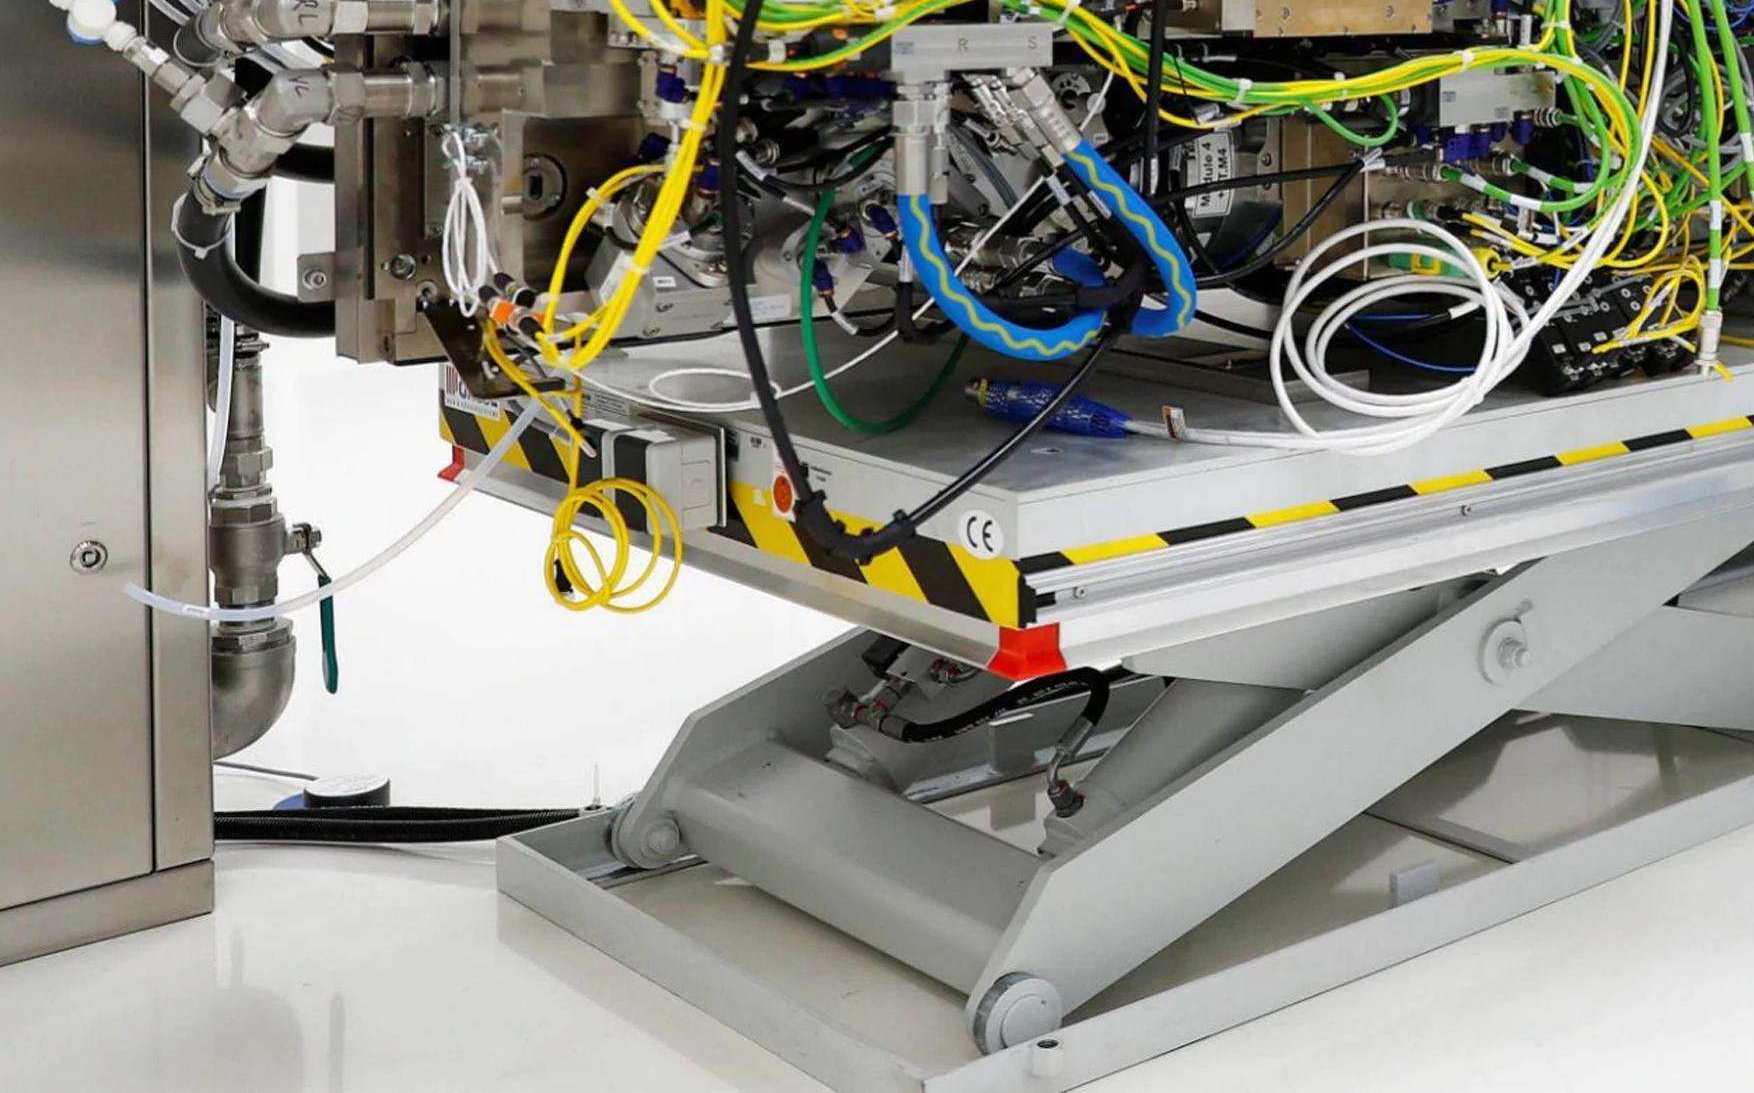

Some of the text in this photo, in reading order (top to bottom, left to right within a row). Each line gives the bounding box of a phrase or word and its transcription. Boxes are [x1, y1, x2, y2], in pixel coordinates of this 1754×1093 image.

[958, 35, 1038, 52] R S
[1201, 154, 1213, 207] Mdule
[1218, 148, 1228, 199] +T.M4
